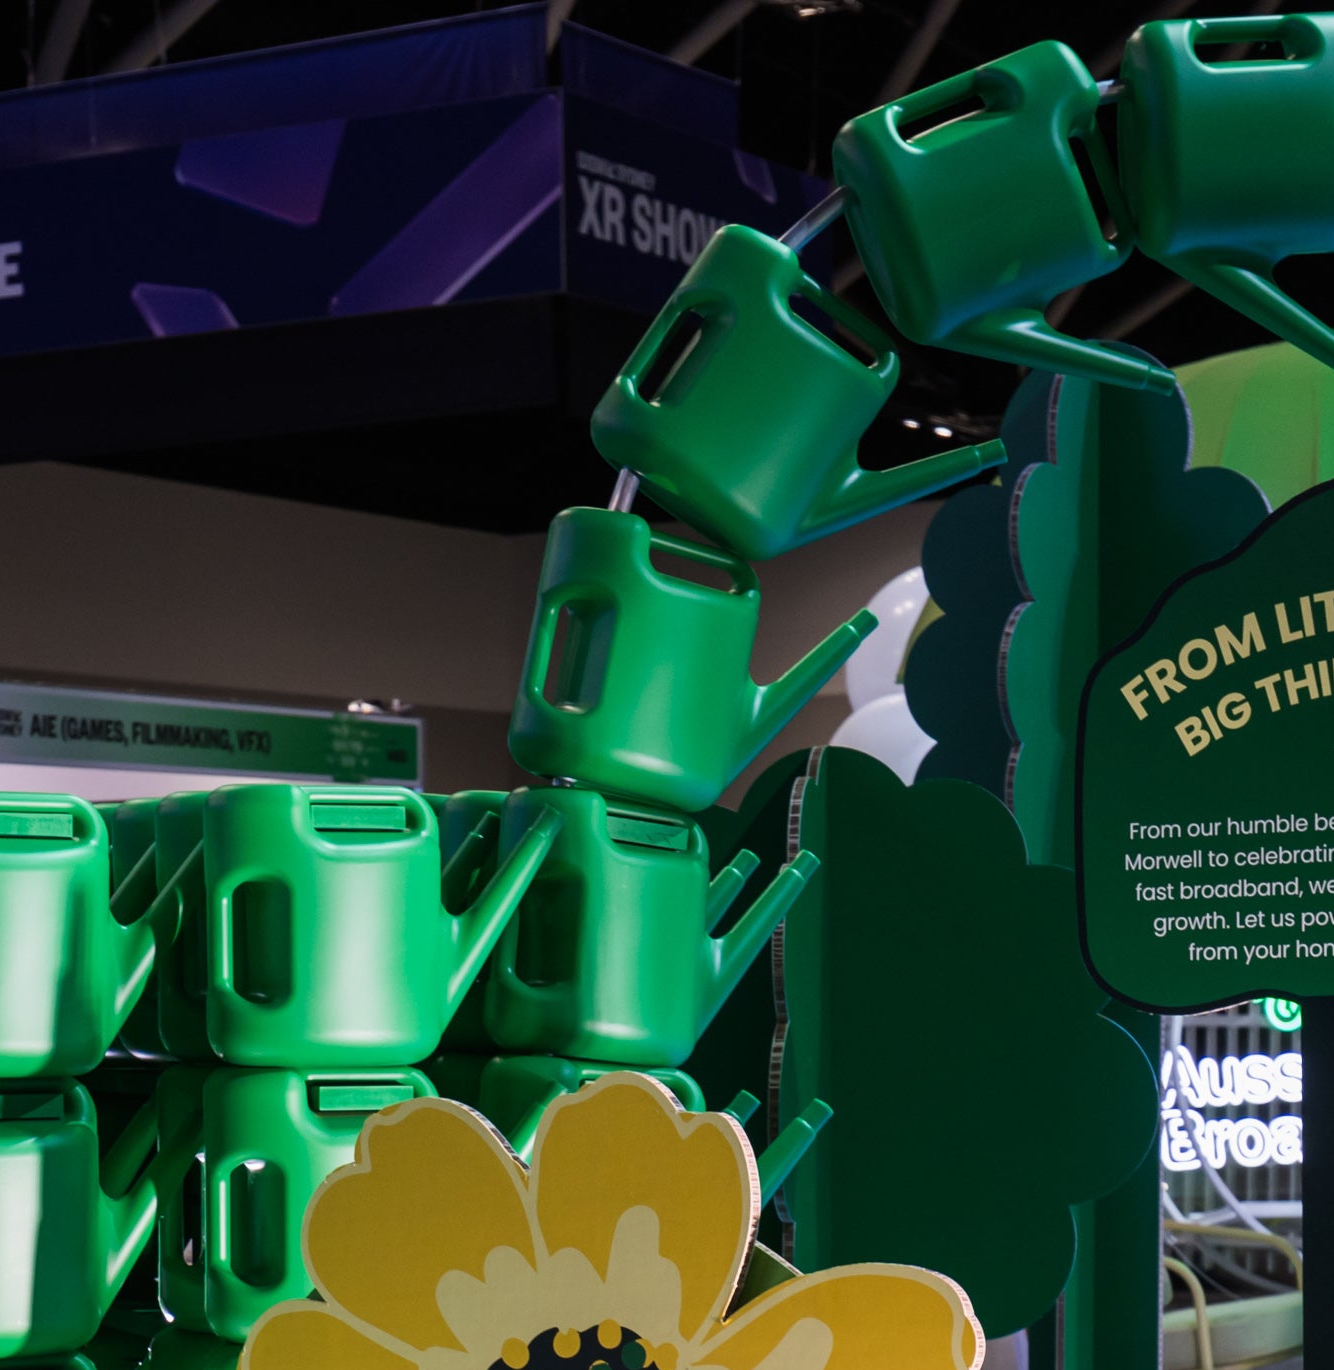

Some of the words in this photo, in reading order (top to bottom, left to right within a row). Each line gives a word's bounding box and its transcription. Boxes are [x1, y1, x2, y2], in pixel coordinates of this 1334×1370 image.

[578, 174, 627, 247] XR
[632, 193, 727, 268] SHOW
[1120, 612, 1267, 721] FROM
[30, 714, 57, 738] AIE
[61, 713, 129, 747] (GAMES,
[132, 721, 234, 754] FILMMAKING,
[1174, 692, 1252, 757] BIG
[1130, 822, 1181, 839] From
[1187, 822, 1221, 837] our
[1228, 815, 1308, 835] humble
[1125, 850, 1202, 871] Morwell
[1208, 851, 1228, 867] to
[1136, 883, 1174, 901] fast
[1180, 876, 1303, 900] broadband,
[1154, 911, 1230, 937] growth.
[1236, 910, 1265, 928] Let
[1271, 913, 1295, 927] us
[1189, 942, 1237, 960] from
[1244, 944, 1290, 965] your
[1161, 1044, 1303, 1108] Auss
